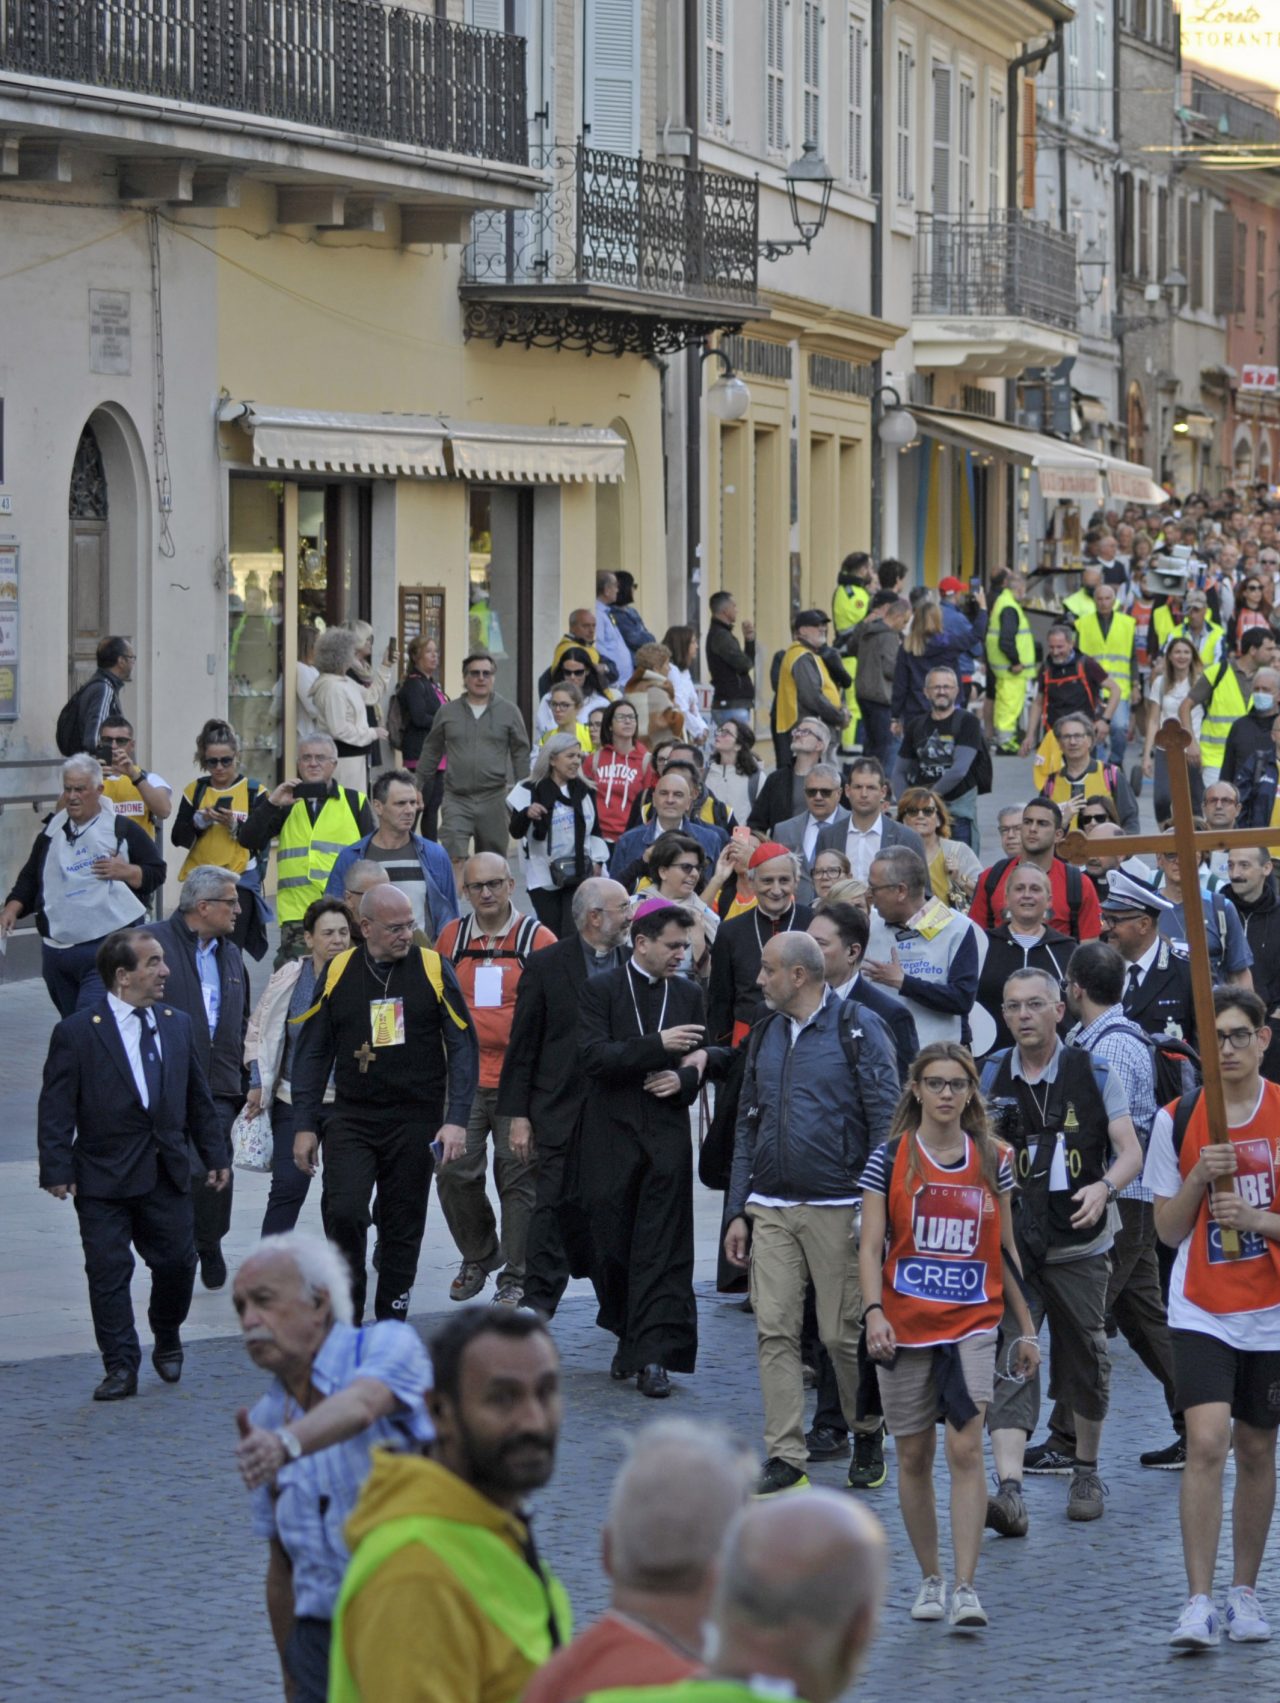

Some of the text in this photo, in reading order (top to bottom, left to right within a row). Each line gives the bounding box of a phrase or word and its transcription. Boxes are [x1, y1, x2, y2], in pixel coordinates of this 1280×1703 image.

[597, 763, 638, 781] VIRTUS
[115, 803, 143, 813] AZIONE
[909, 965, 943, 975] Loreto
[916, 1216, 975, 1252] LUBE
[903, 1263, 978, 1290] CREO
